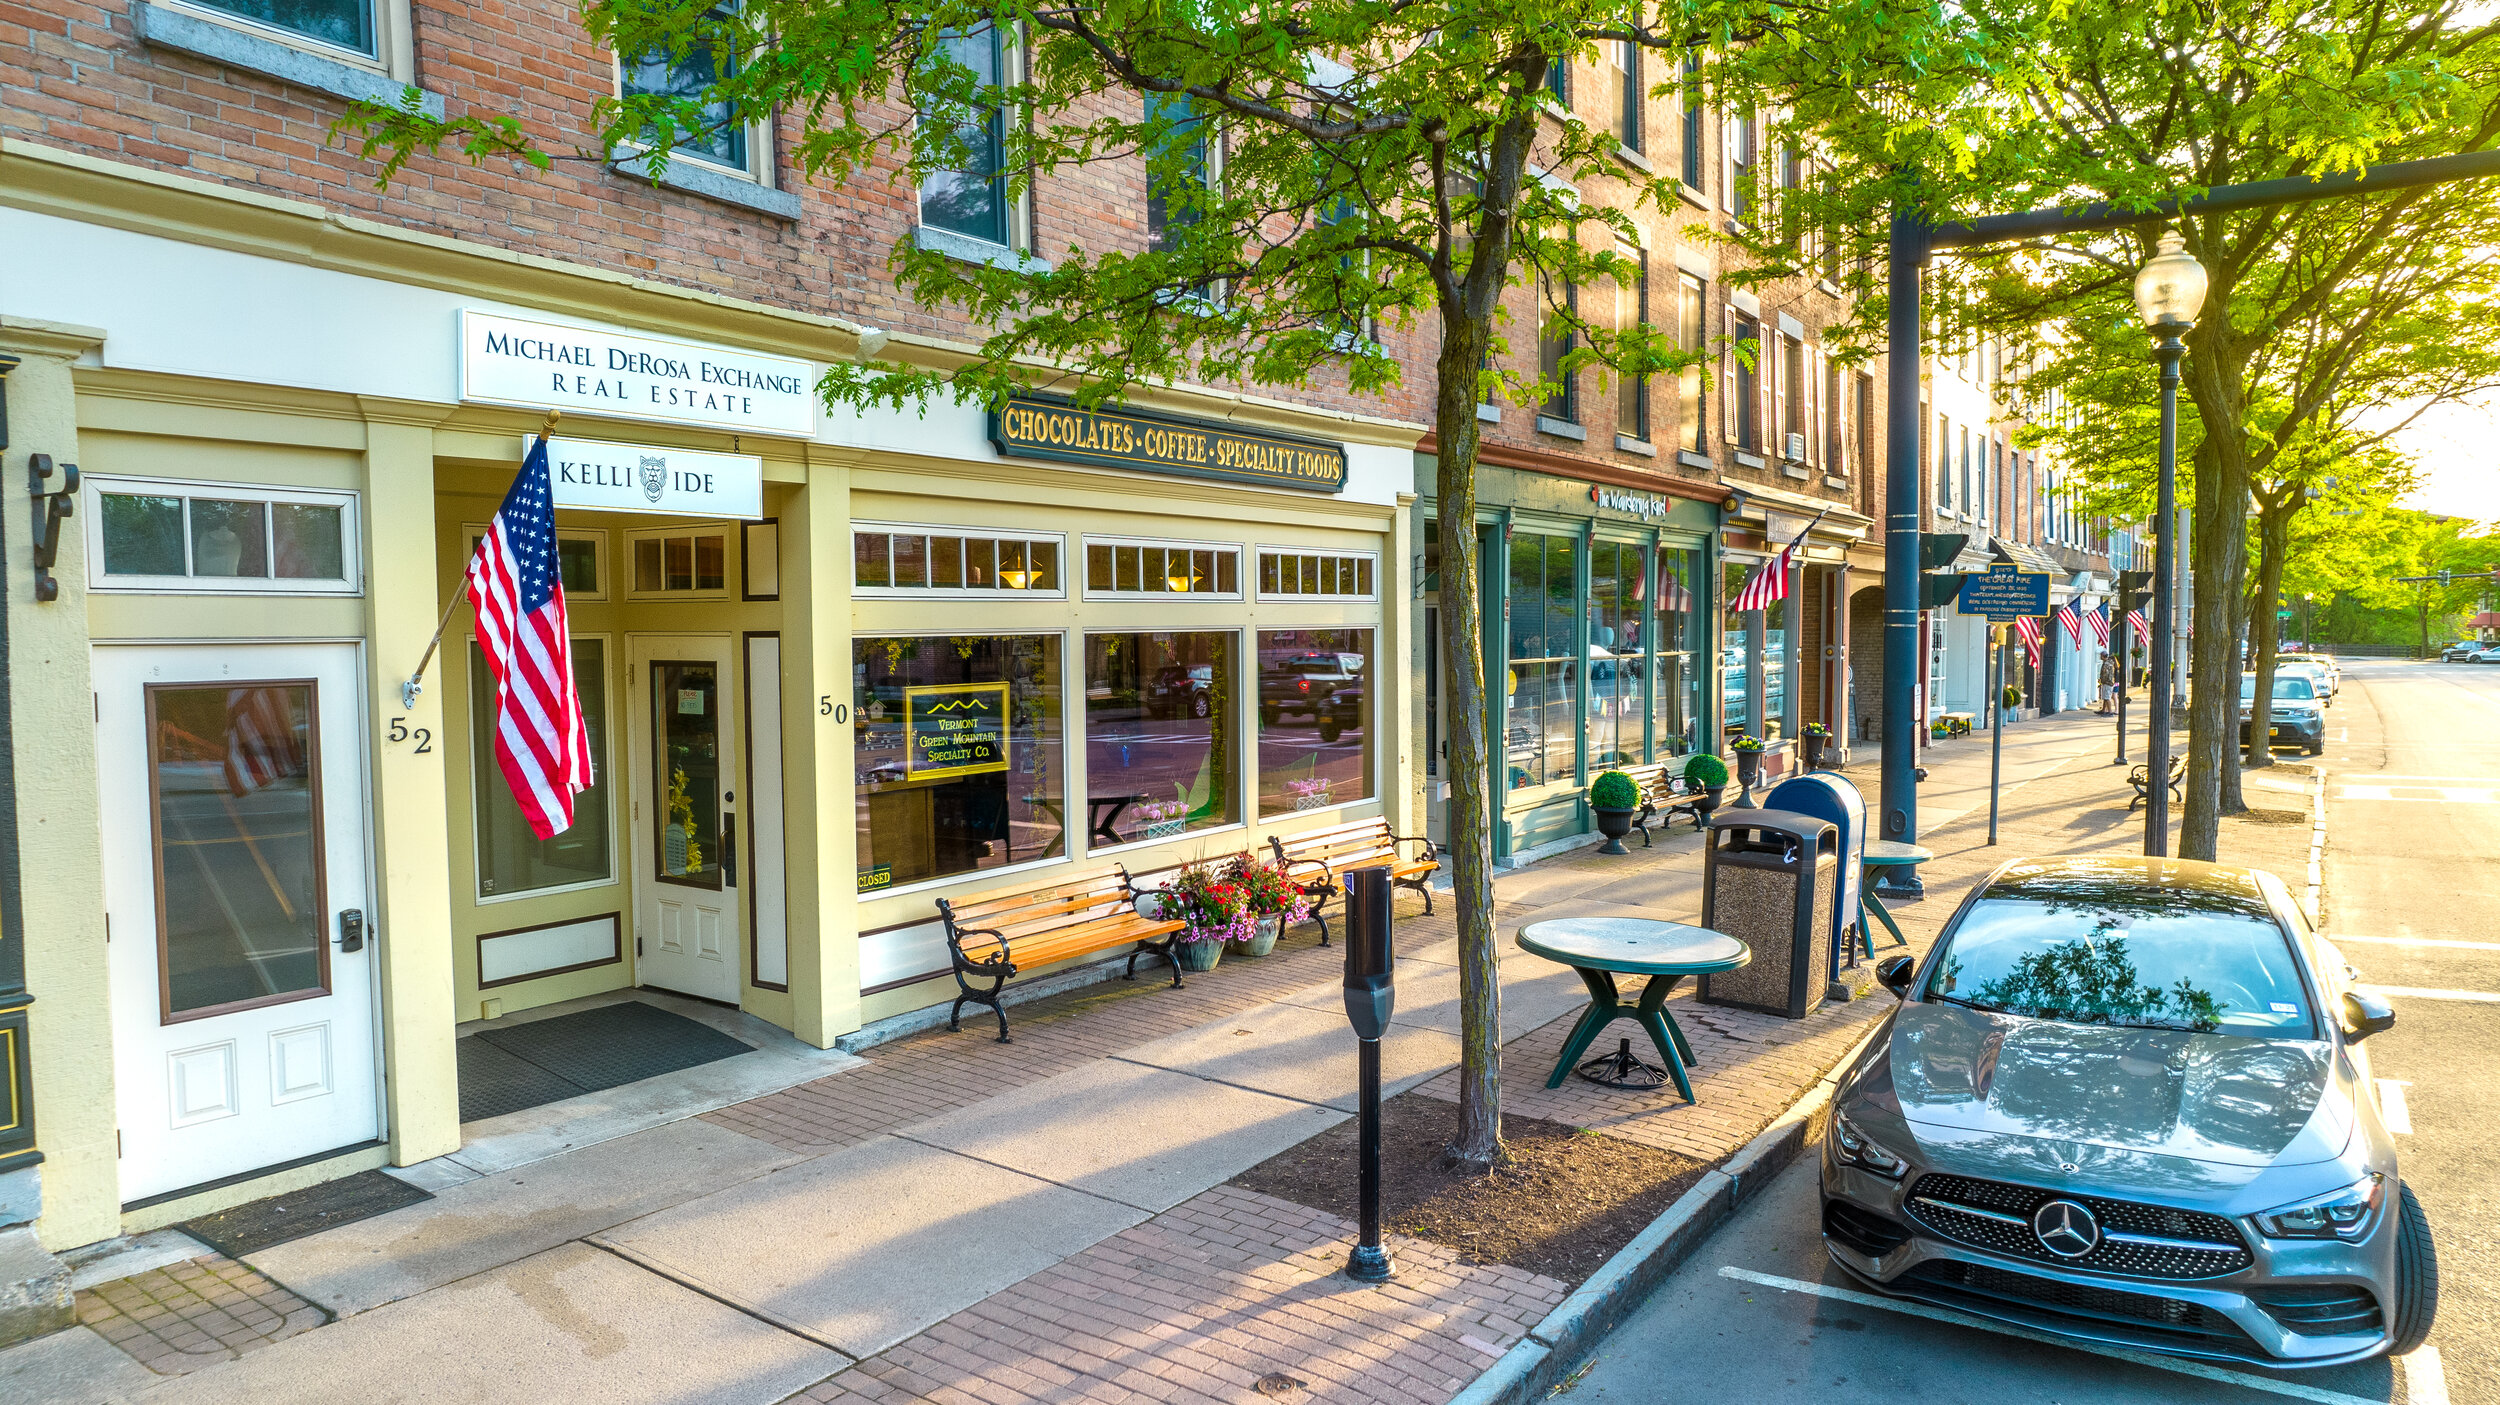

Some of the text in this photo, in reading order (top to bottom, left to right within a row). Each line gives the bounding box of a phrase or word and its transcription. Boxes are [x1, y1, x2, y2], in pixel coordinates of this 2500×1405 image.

[485, 330, 596, 367] MICHAEL
[700, 361, 802, 395] EXCHANGE
[552, 372, 752, 414] REAL ESTATE
[1005, 407, 1340, 480] CHOCOLATES COFFEE SPECIALTY FOODS
[559, 461, 714, 494] KELLI IDE
[820, 695, 848, 724] 50
[938, 719, 978, 731] VERMONT
[389, 716, 431, 754] 52
[919, 732, 996, 748] GREEN MOUNTAIN
[928, 748, 971, 763] SPECIALTY
[857, 871, 891, 888] CLOSED
